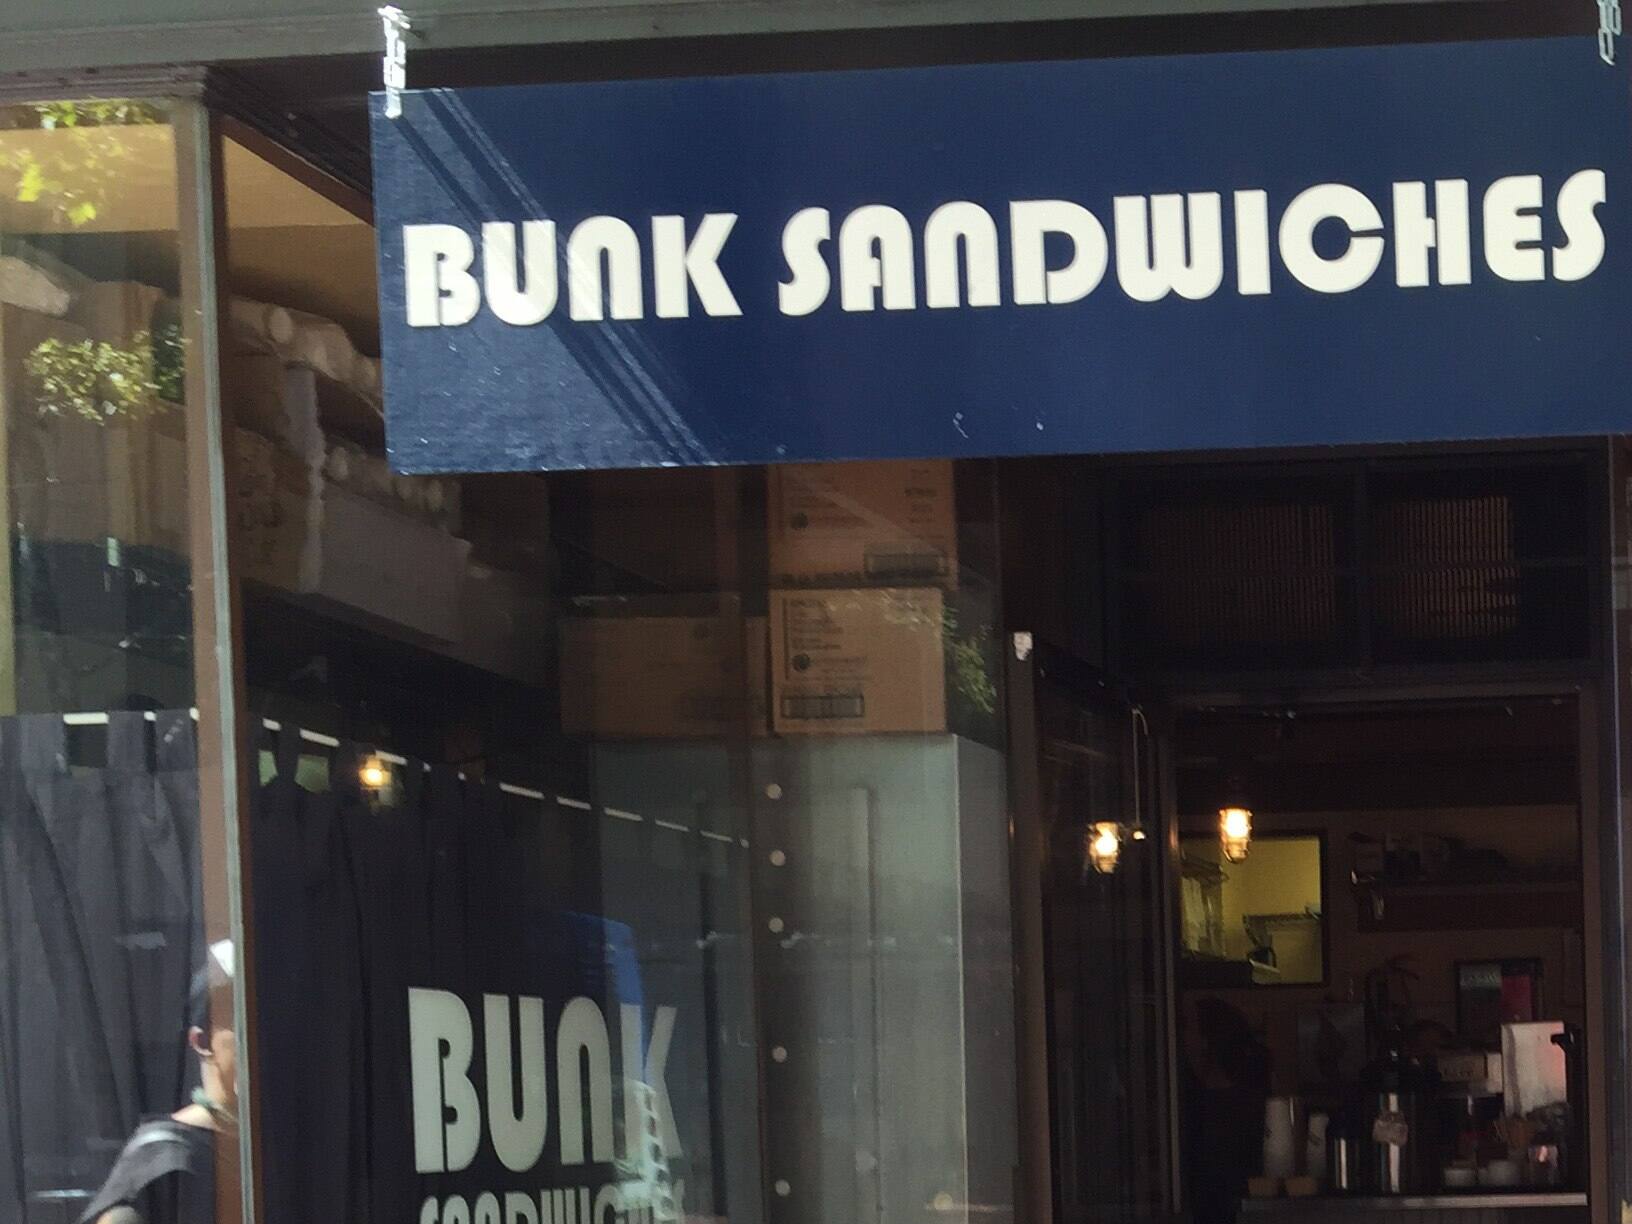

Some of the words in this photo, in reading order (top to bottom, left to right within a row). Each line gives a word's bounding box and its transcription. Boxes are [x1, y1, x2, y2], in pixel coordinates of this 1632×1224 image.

[403, 211, 742, 329] BUNK
[776, 167, 1607, 319] SANDWICHES
[408, 986, 683, 1174] BUNK
